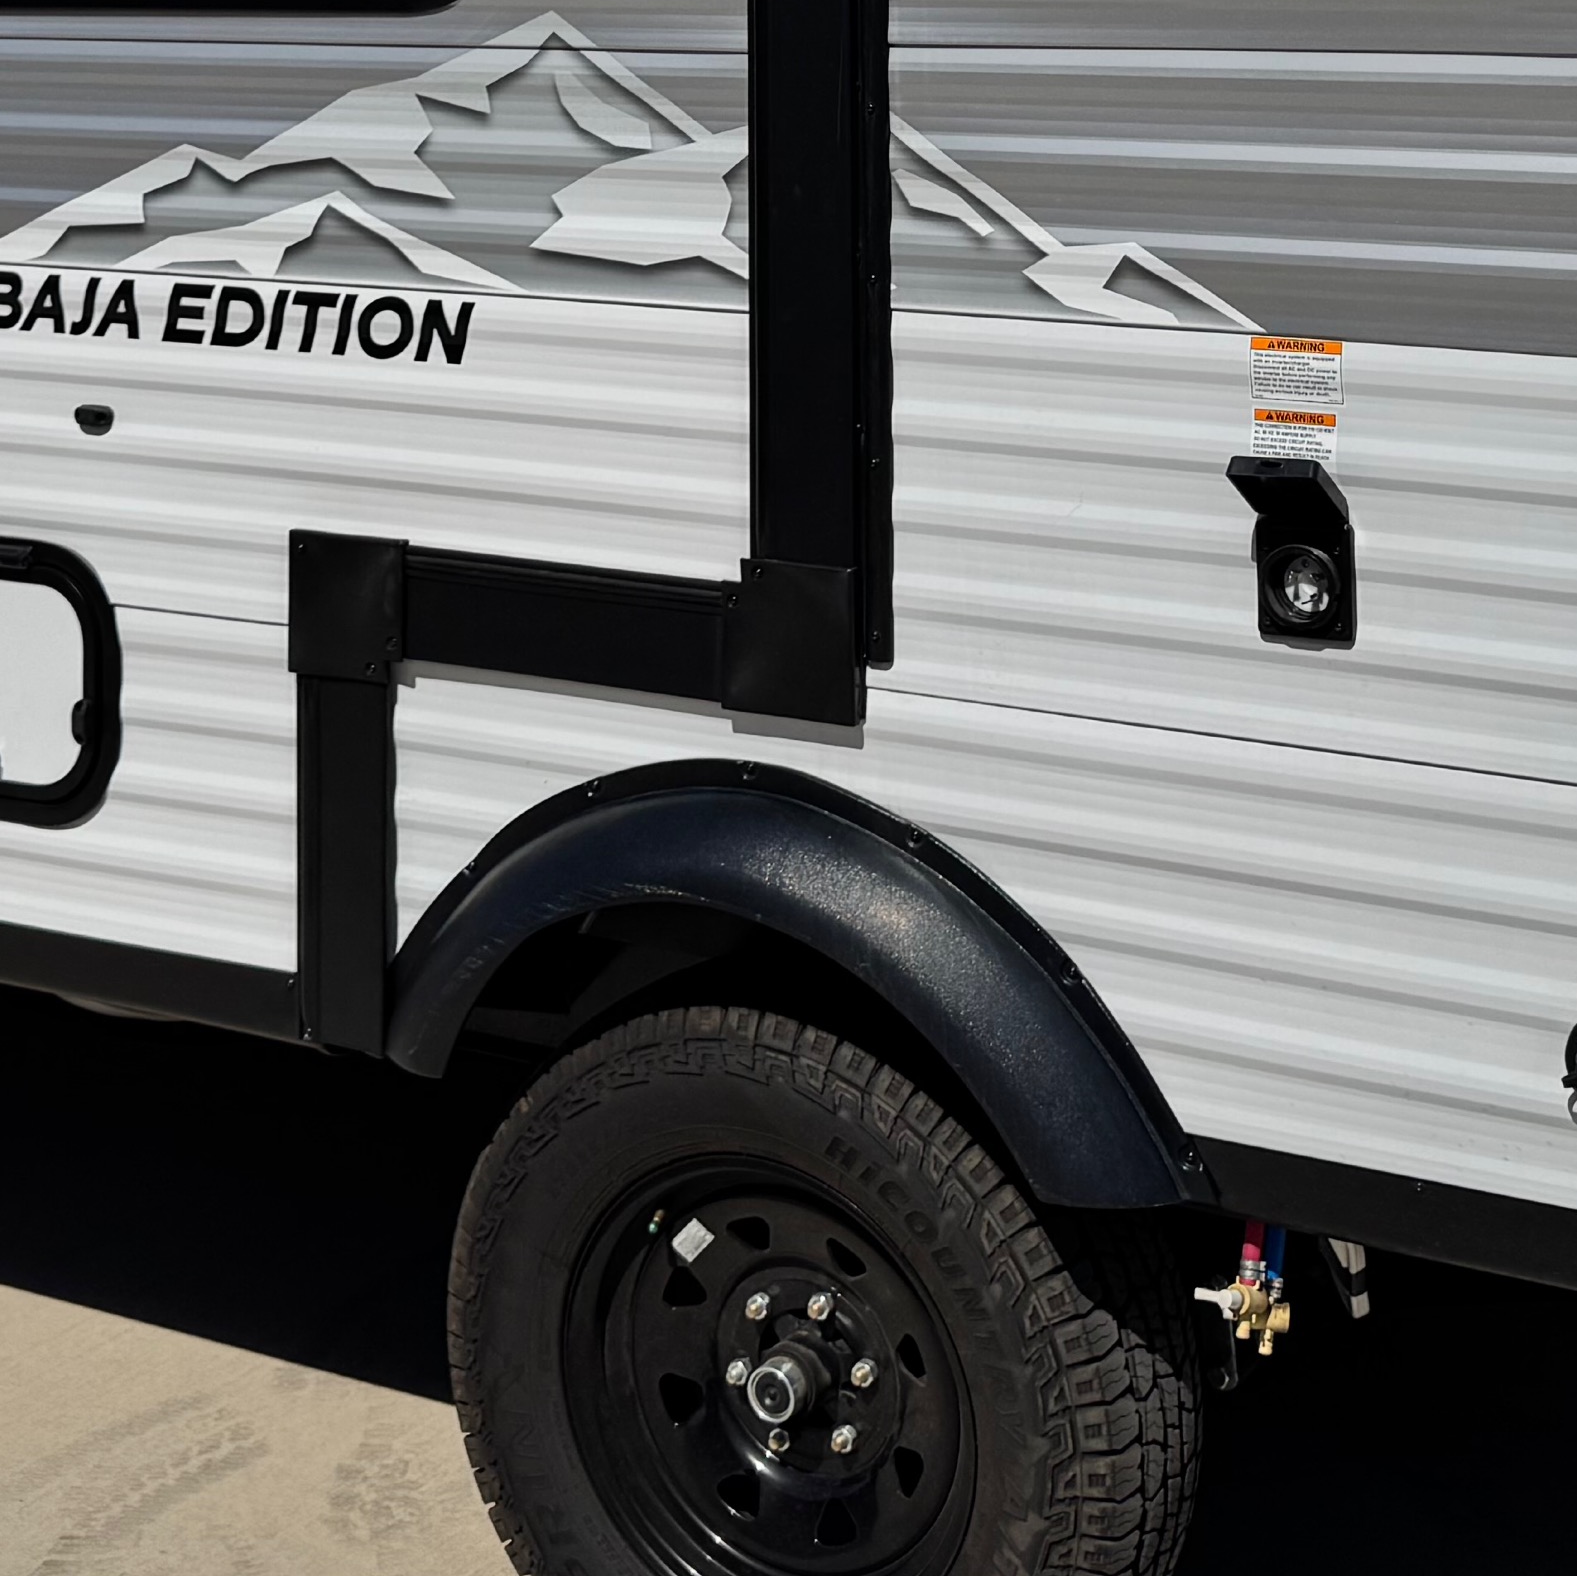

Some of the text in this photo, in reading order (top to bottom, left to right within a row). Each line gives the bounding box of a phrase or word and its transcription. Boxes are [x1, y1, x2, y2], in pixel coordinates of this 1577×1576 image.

[162, 283, 475, 365] EDITION
[1277, 340, 1325, 352] WARNING
[1275, 412, 1324, 424] WARNING
